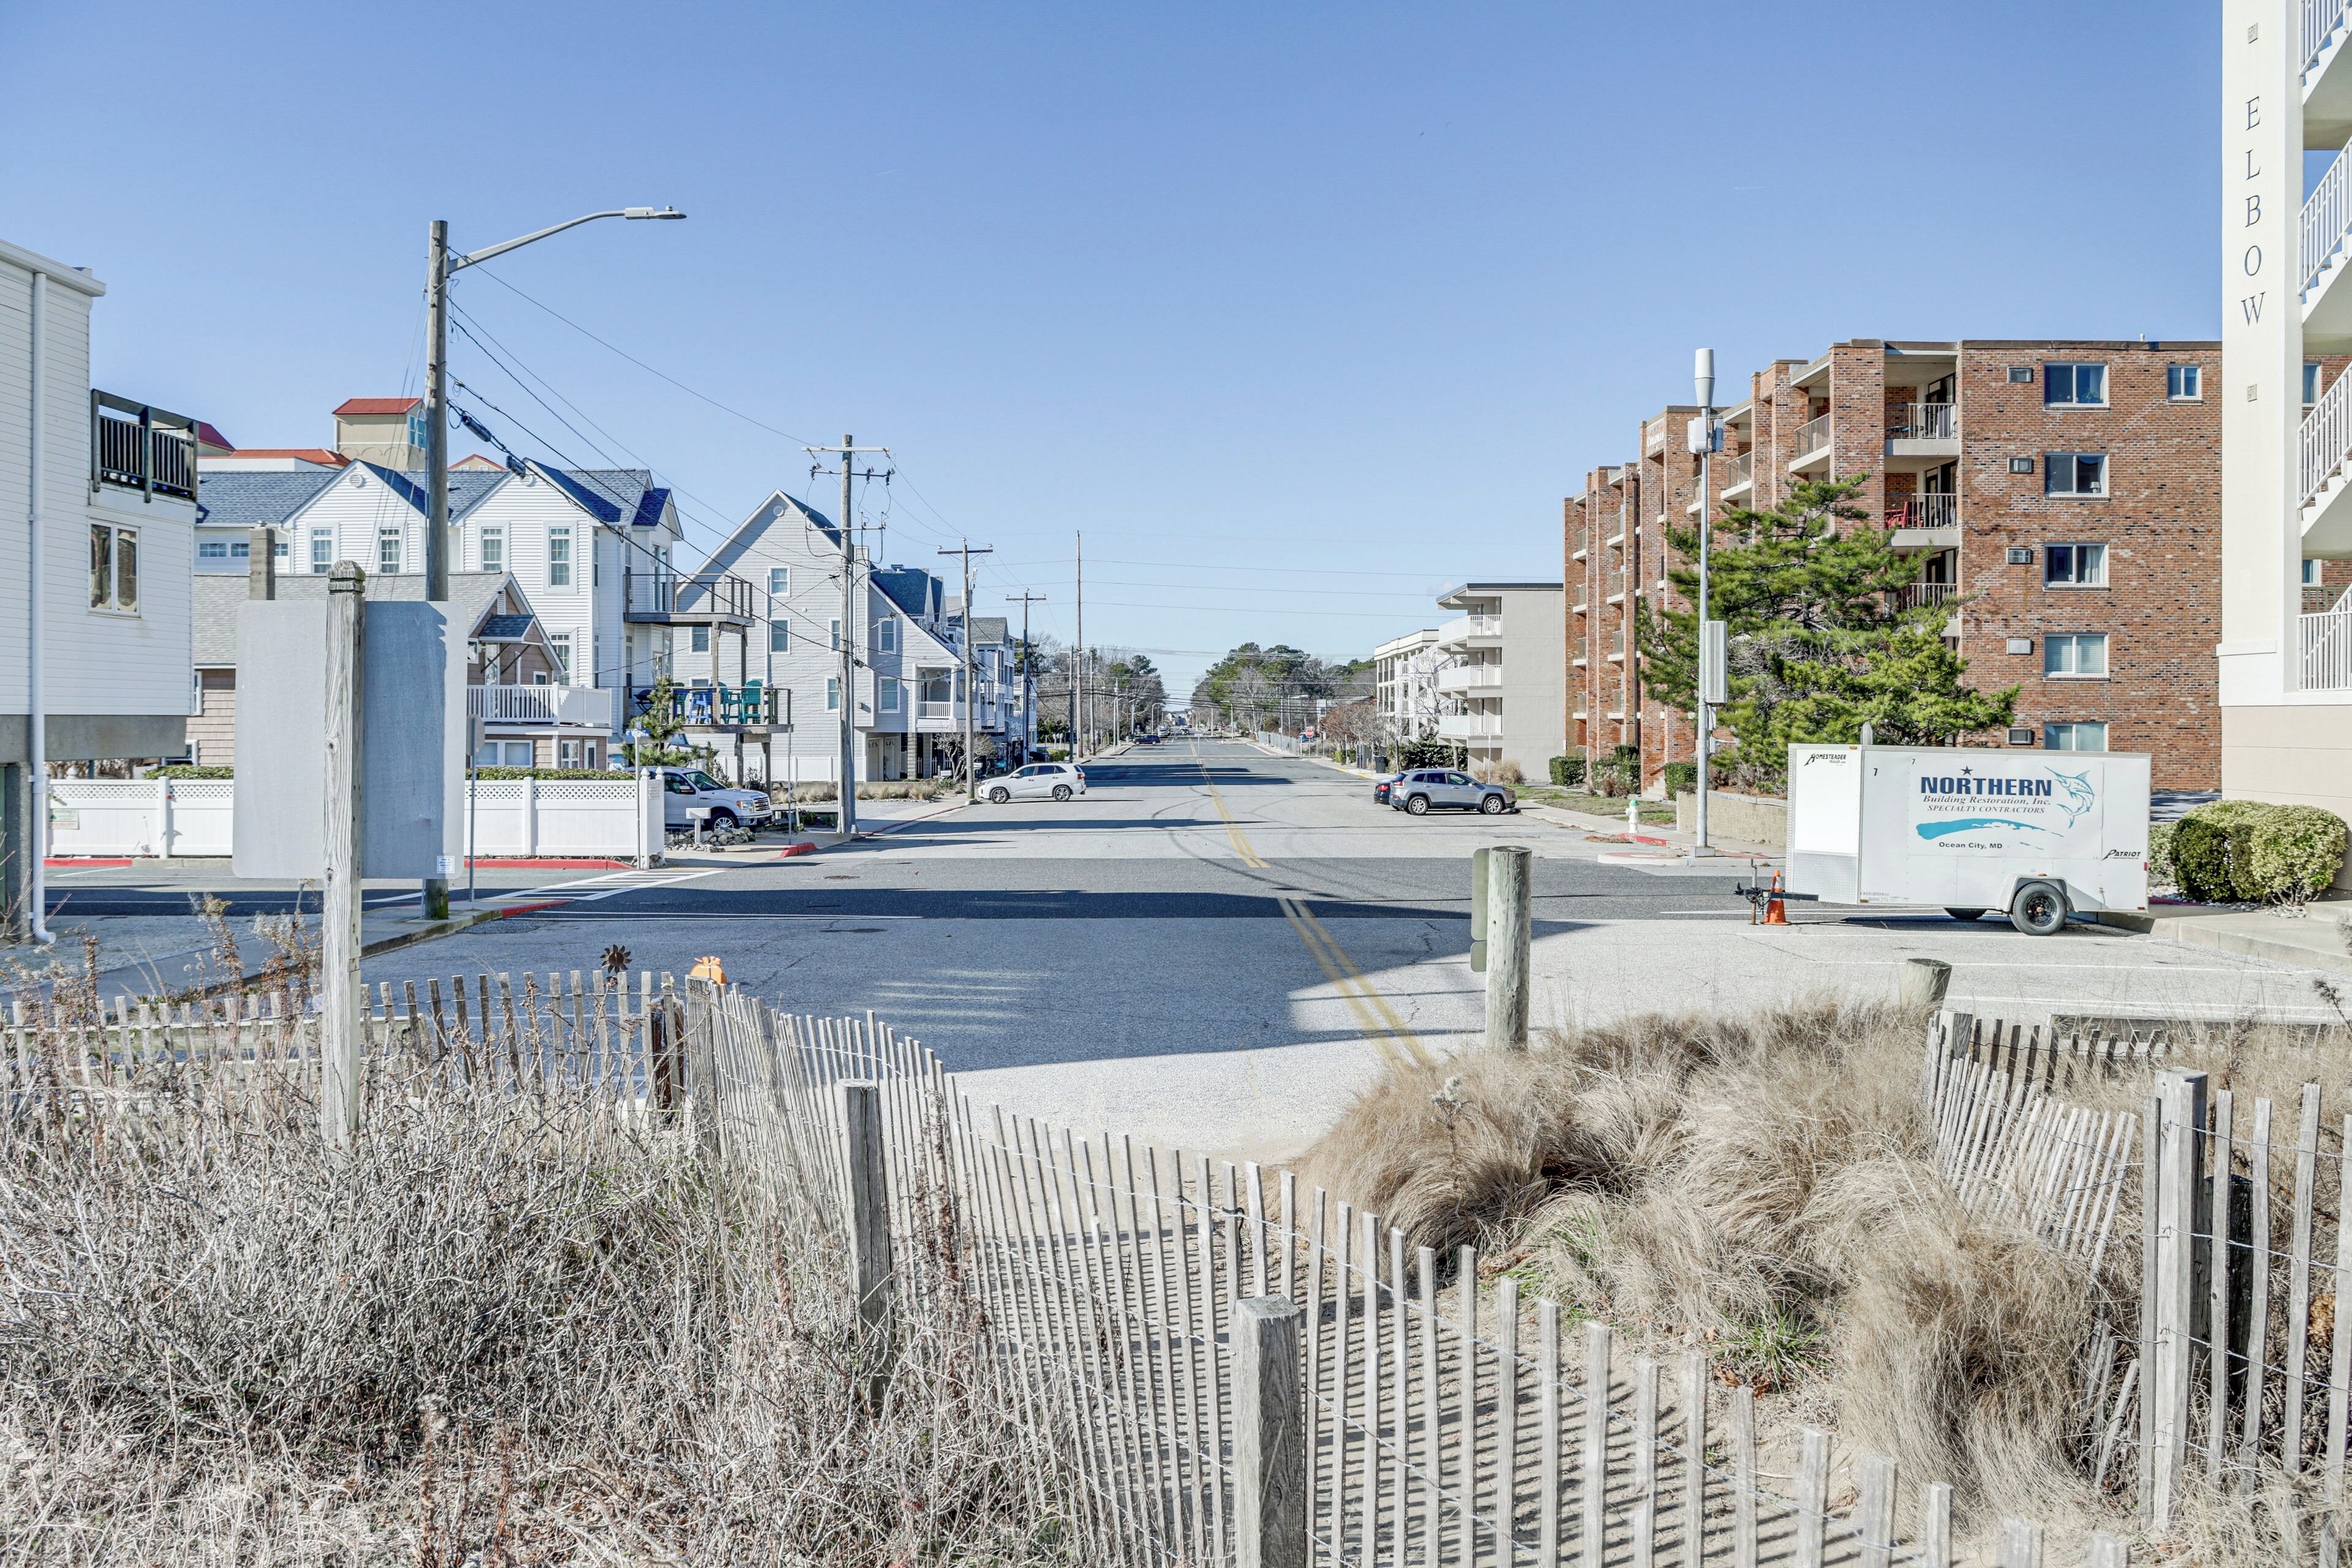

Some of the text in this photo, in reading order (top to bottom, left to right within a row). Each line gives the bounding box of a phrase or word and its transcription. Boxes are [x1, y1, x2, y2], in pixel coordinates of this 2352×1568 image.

[2240, 96, 2266, 326] ELBOW
[1803, 753, 1846, 766] HOMESTEADER
[1921, 777, 2052, 796] NORTHERN
[1923, 795, 1966, 804] Building
[1969, 796, 2029, 805] Restoration,
[2101, 850, 2141, 861] PATRIOT
